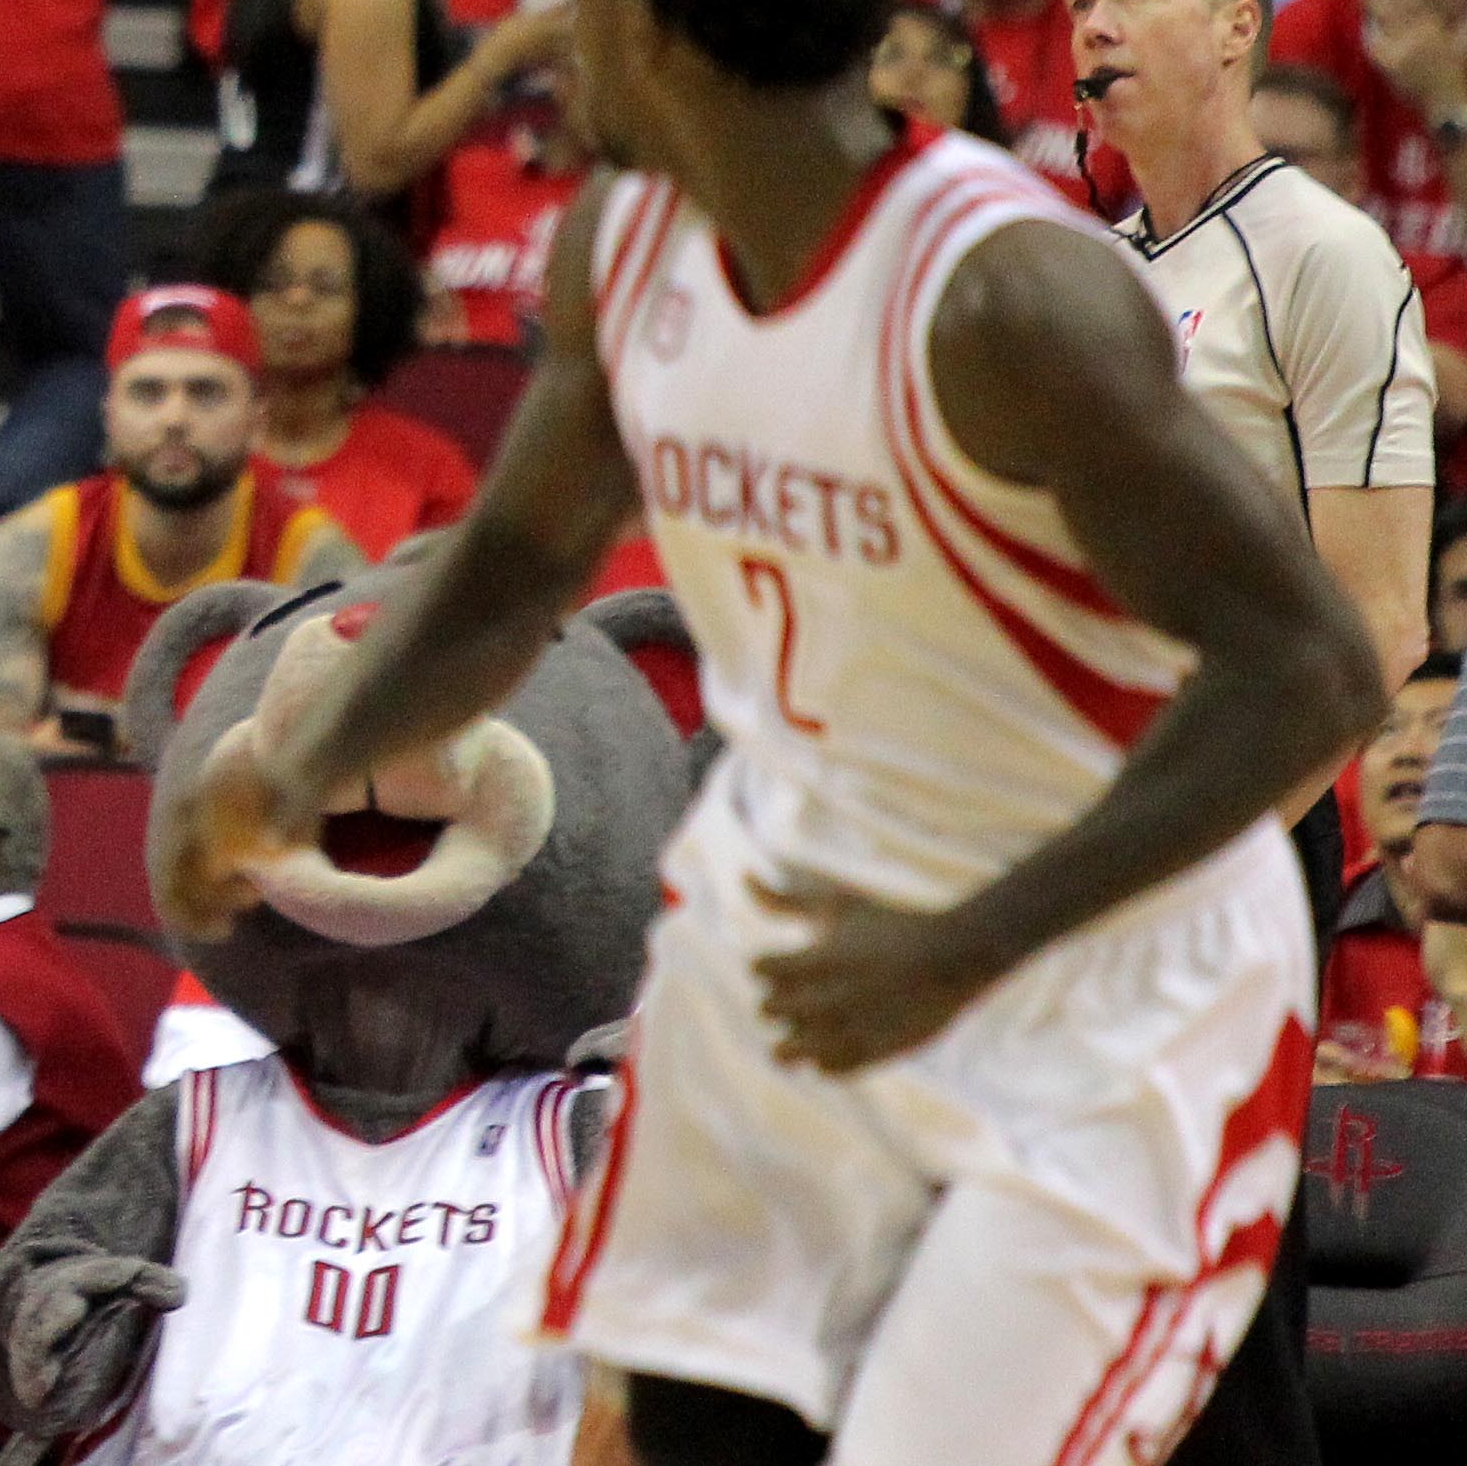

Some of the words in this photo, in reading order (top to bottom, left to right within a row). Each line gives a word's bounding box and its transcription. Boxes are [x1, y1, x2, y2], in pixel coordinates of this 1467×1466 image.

[653, 437, 903, 567] OCKETS
[737, 546, 830, 734] 2
[230, 1179, 498, 1255] ROCKETS
[304, 1258, 404, 1341] 00
